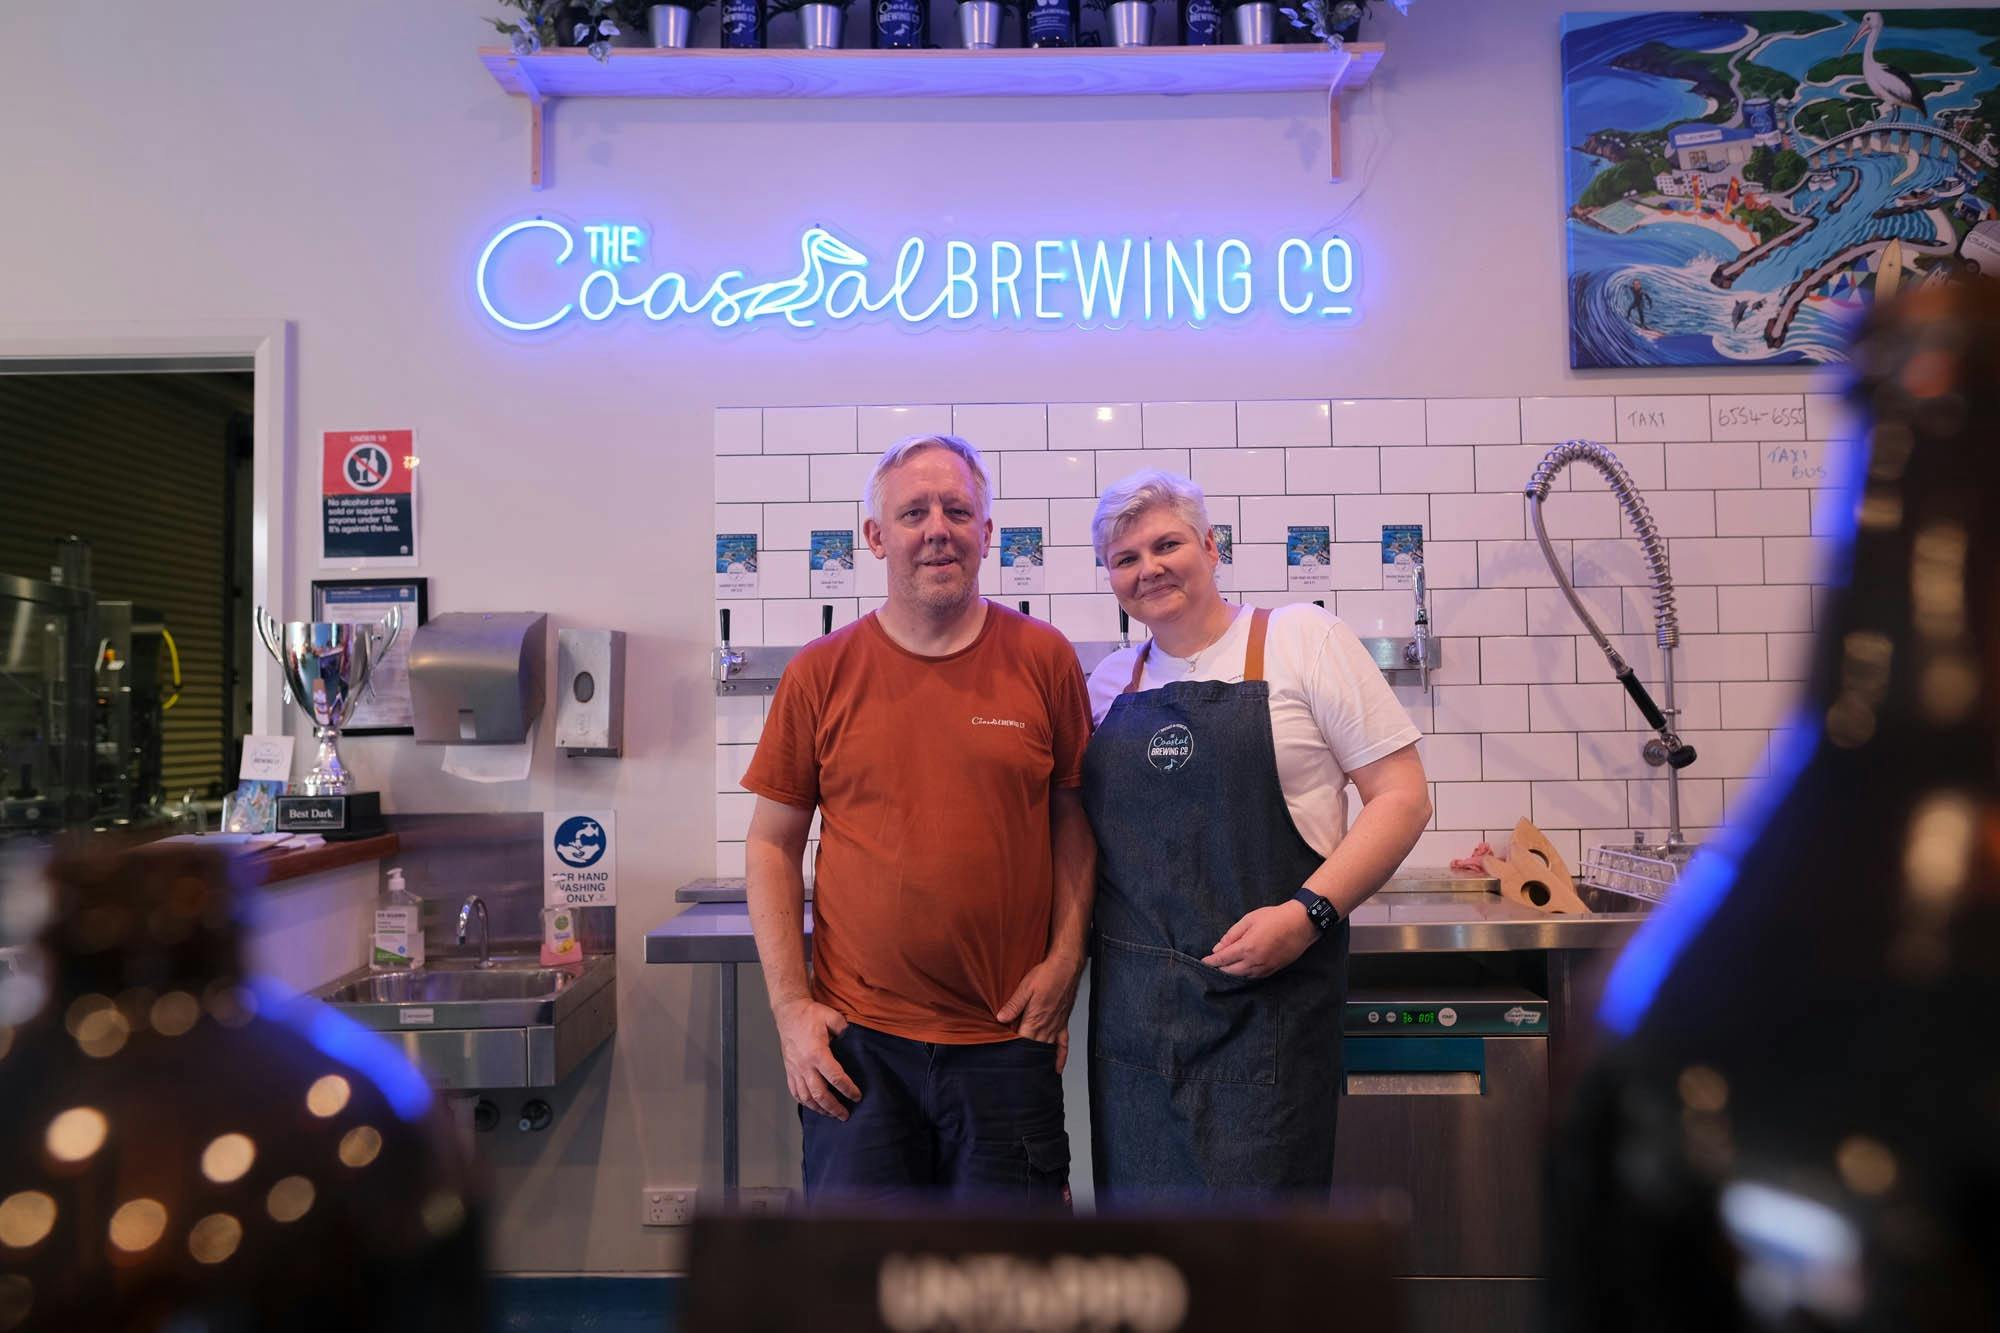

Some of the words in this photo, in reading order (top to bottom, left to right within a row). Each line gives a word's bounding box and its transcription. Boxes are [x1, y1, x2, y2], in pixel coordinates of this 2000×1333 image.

[583, 225, 641, 265] THE
[946, 238, 1253, 321] BREWING
[1277, 237, 1353, 315] CO
[1627, 410, 1665, 428] TAXI
[327, 498, 339, 506] No
[341, 498, 369, 506] alcohol
[385, 497, 396, 505] be
[328, 507, 345, 515] sold
[356, 507, 388, 517] supplied
[389, 506, 398, 514] to
[357, 516, 380, 524] under
[1153, 735, 1189, 747] Coastal
[1151, 746, 1179, 756] BREWING
[1180, 746, 1189, 756] CO
[289, 808, 309, 819] Best
[311, 808, 333, 818] Dark
[577, 872, 609, 881] HAND
[566, 894, 595, 904] ONLY
